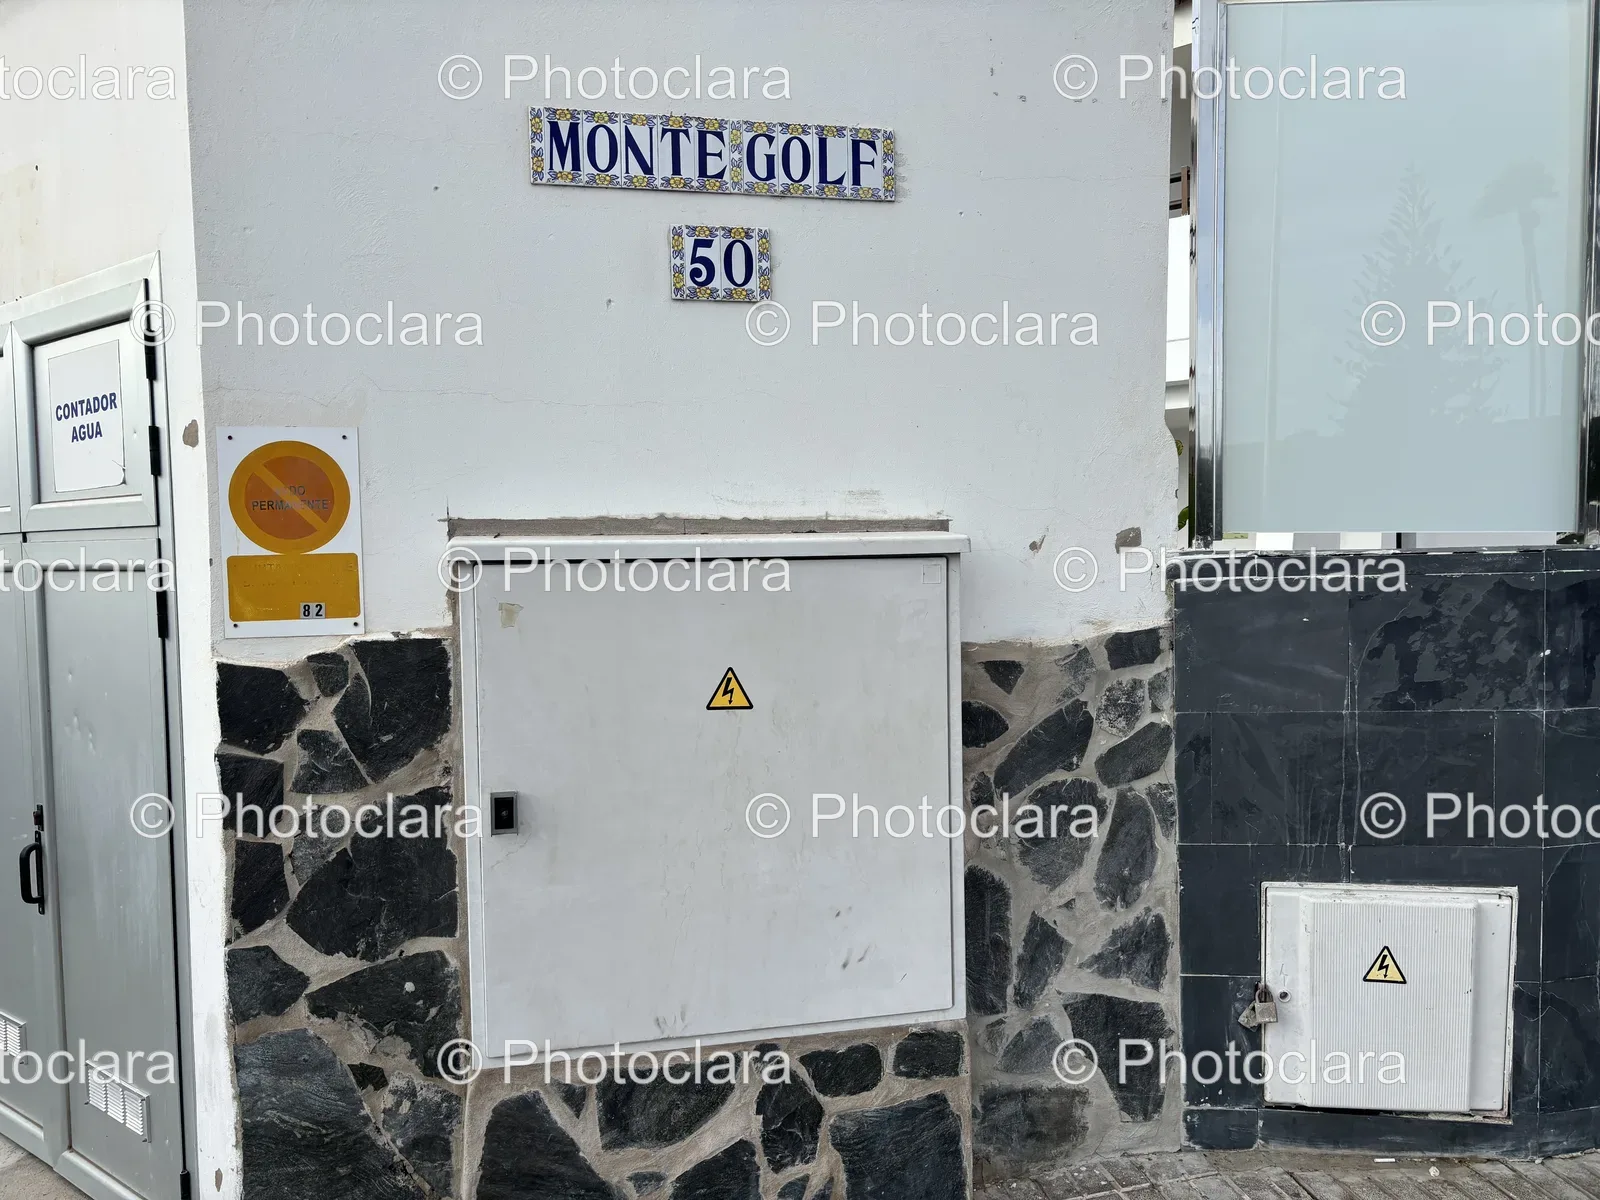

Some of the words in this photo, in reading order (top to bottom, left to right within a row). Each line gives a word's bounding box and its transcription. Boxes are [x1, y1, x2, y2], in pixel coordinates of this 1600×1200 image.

[547, 120, 729, 180] MONTE
[745, 132, 879, 187] GOLF
[688, 237, 755, 288] 50
[55, 392, 118, 422] CONTADOR
[71, 421, 103, 443] AGUA
